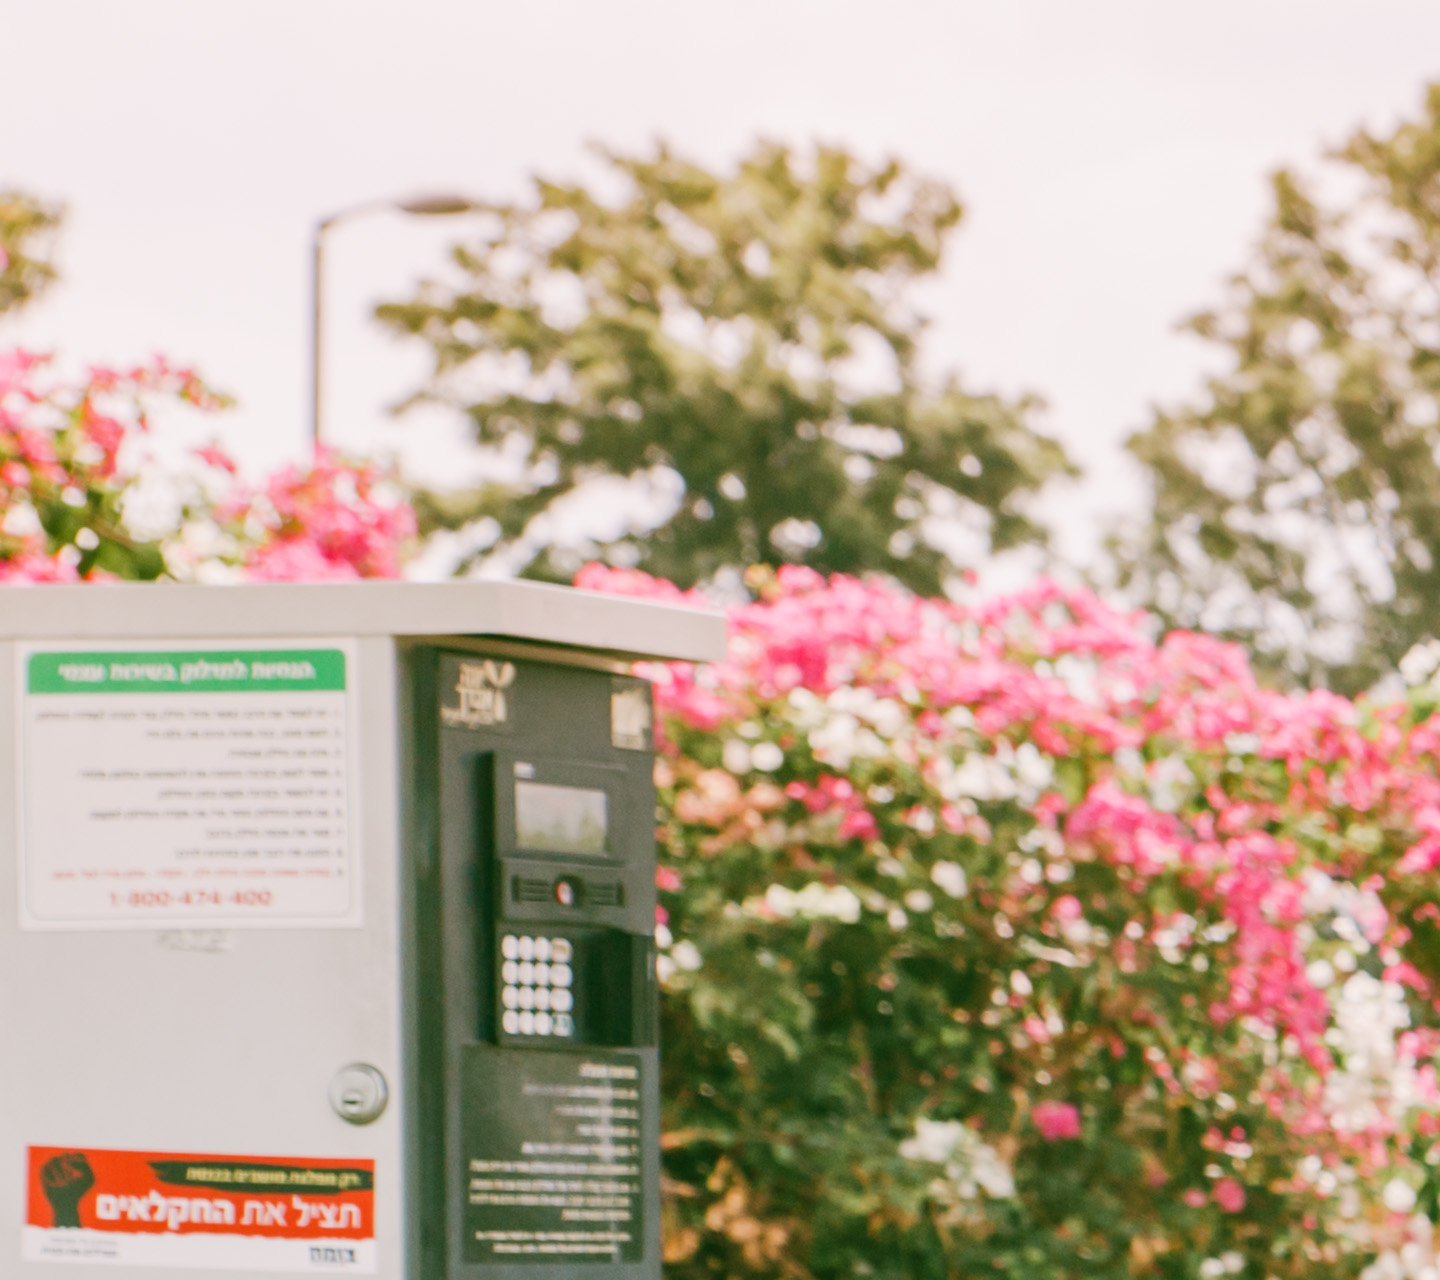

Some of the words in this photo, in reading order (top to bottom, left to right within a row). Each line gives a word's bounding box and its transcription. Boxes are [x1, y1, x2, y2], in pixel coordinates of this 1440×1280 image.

[96, 1190, 236, 1229] החקלאים
[241, 1200, 286, 1226] את
[290, 1192, 361, 1228] תציל
